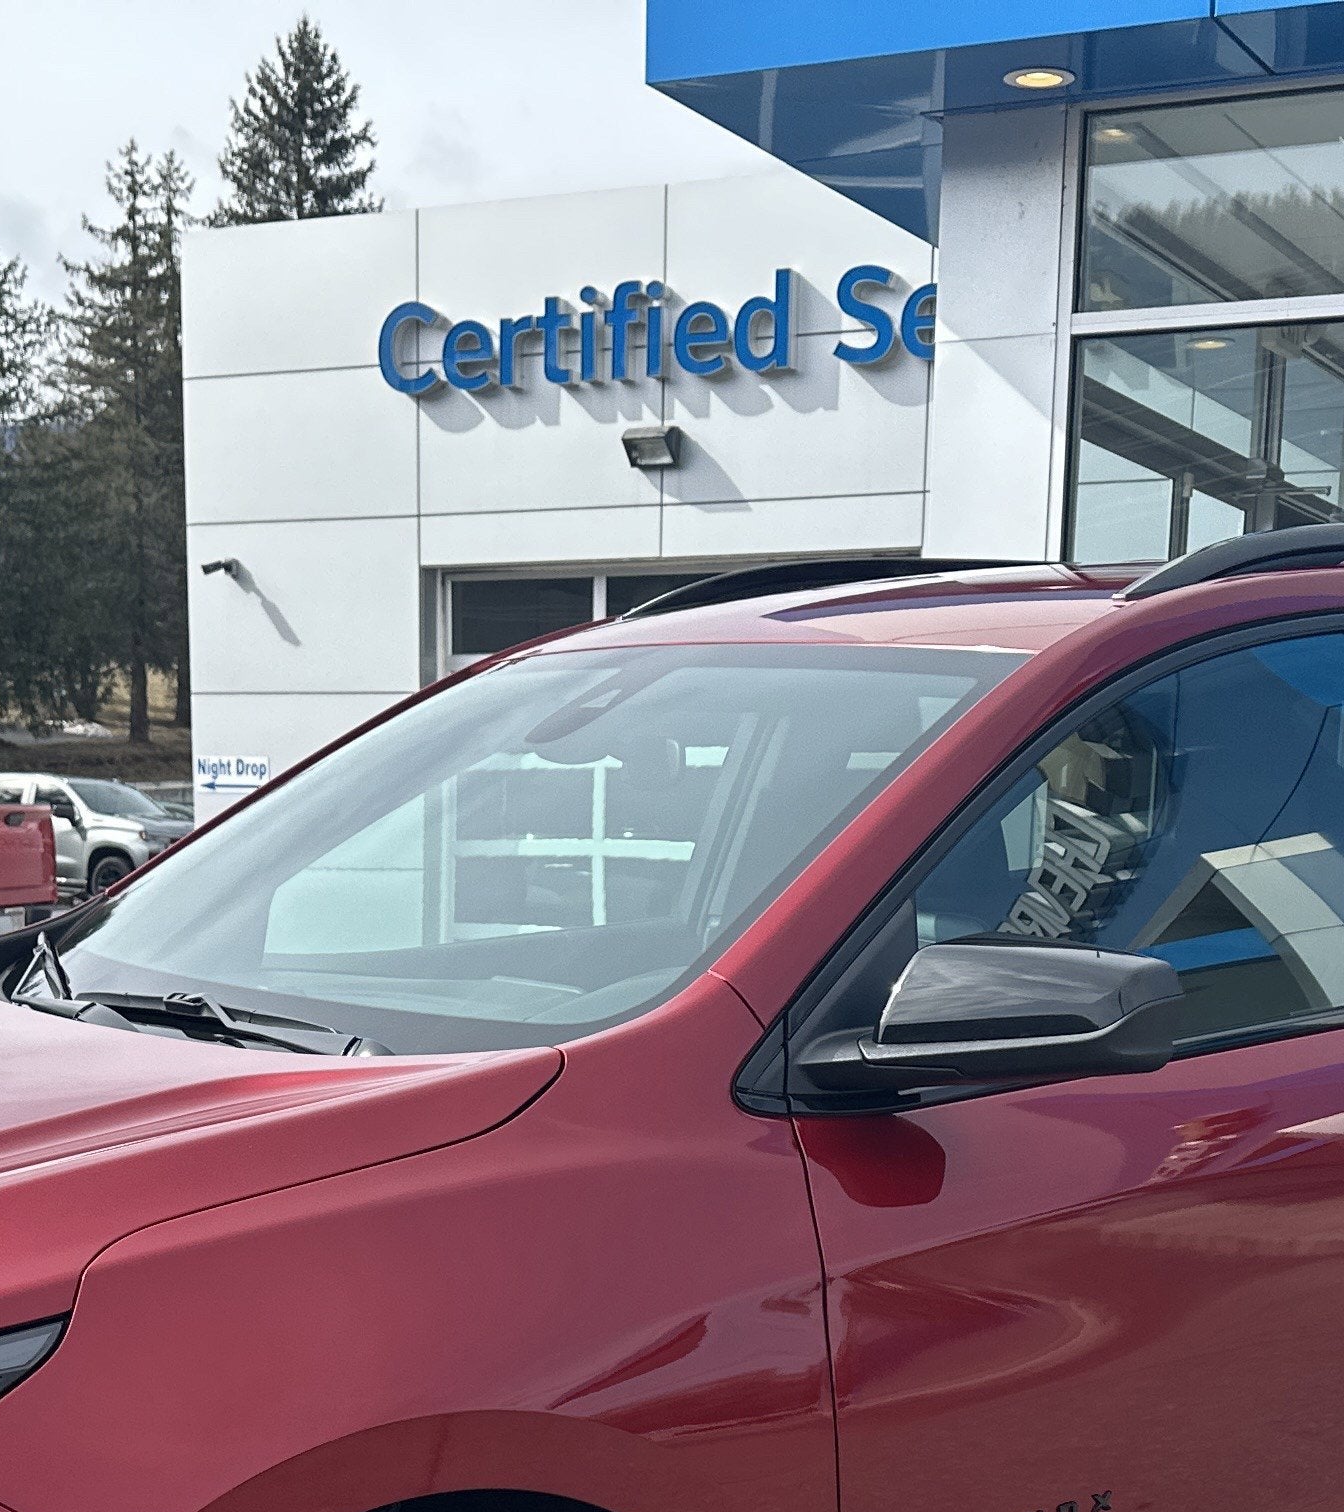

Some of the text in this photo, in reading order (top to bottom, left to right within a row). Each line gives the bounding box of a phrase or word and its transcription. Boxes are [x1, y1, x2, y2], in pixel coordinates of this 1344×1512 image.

[378, 267, 794, 395] Certified
[197, 758, 267, 780] Night Drop
